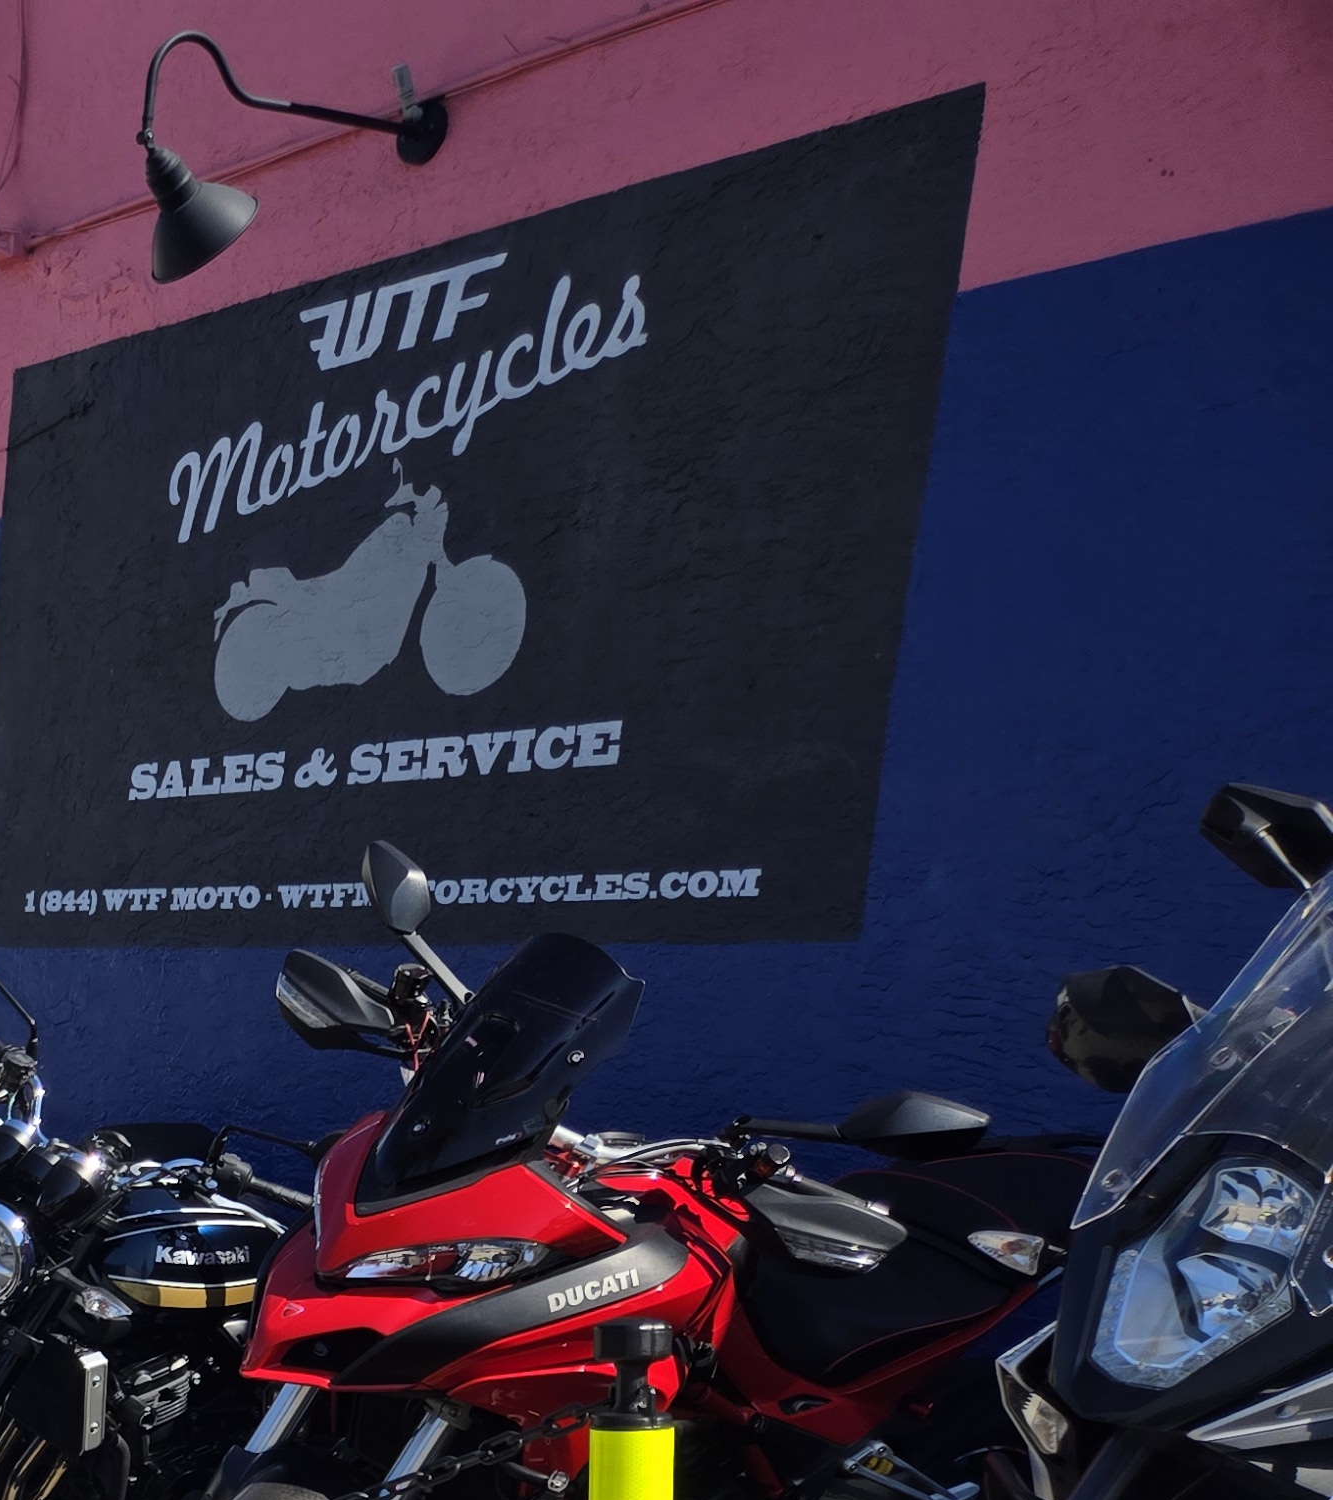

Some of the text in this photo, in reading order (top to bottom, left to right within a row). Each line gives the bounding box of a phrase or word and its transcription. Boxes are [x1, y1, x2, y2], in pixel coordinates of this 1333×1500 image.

[299, 252, 508, 371] WTF
[169, 274, 648, 543] Motorcycles
[127, 720, 624, 801] SALES & SERVICE
[24, 890, 36, 912] 1
[39, 889, 98, 916] (844)
[102, 888, 167, 912] WTF
[169, 885, 261, 911] MOTO
[155, 1245, 250, 1266] Kawasaki
[547, 1268, 640, 1313] DUCATI
